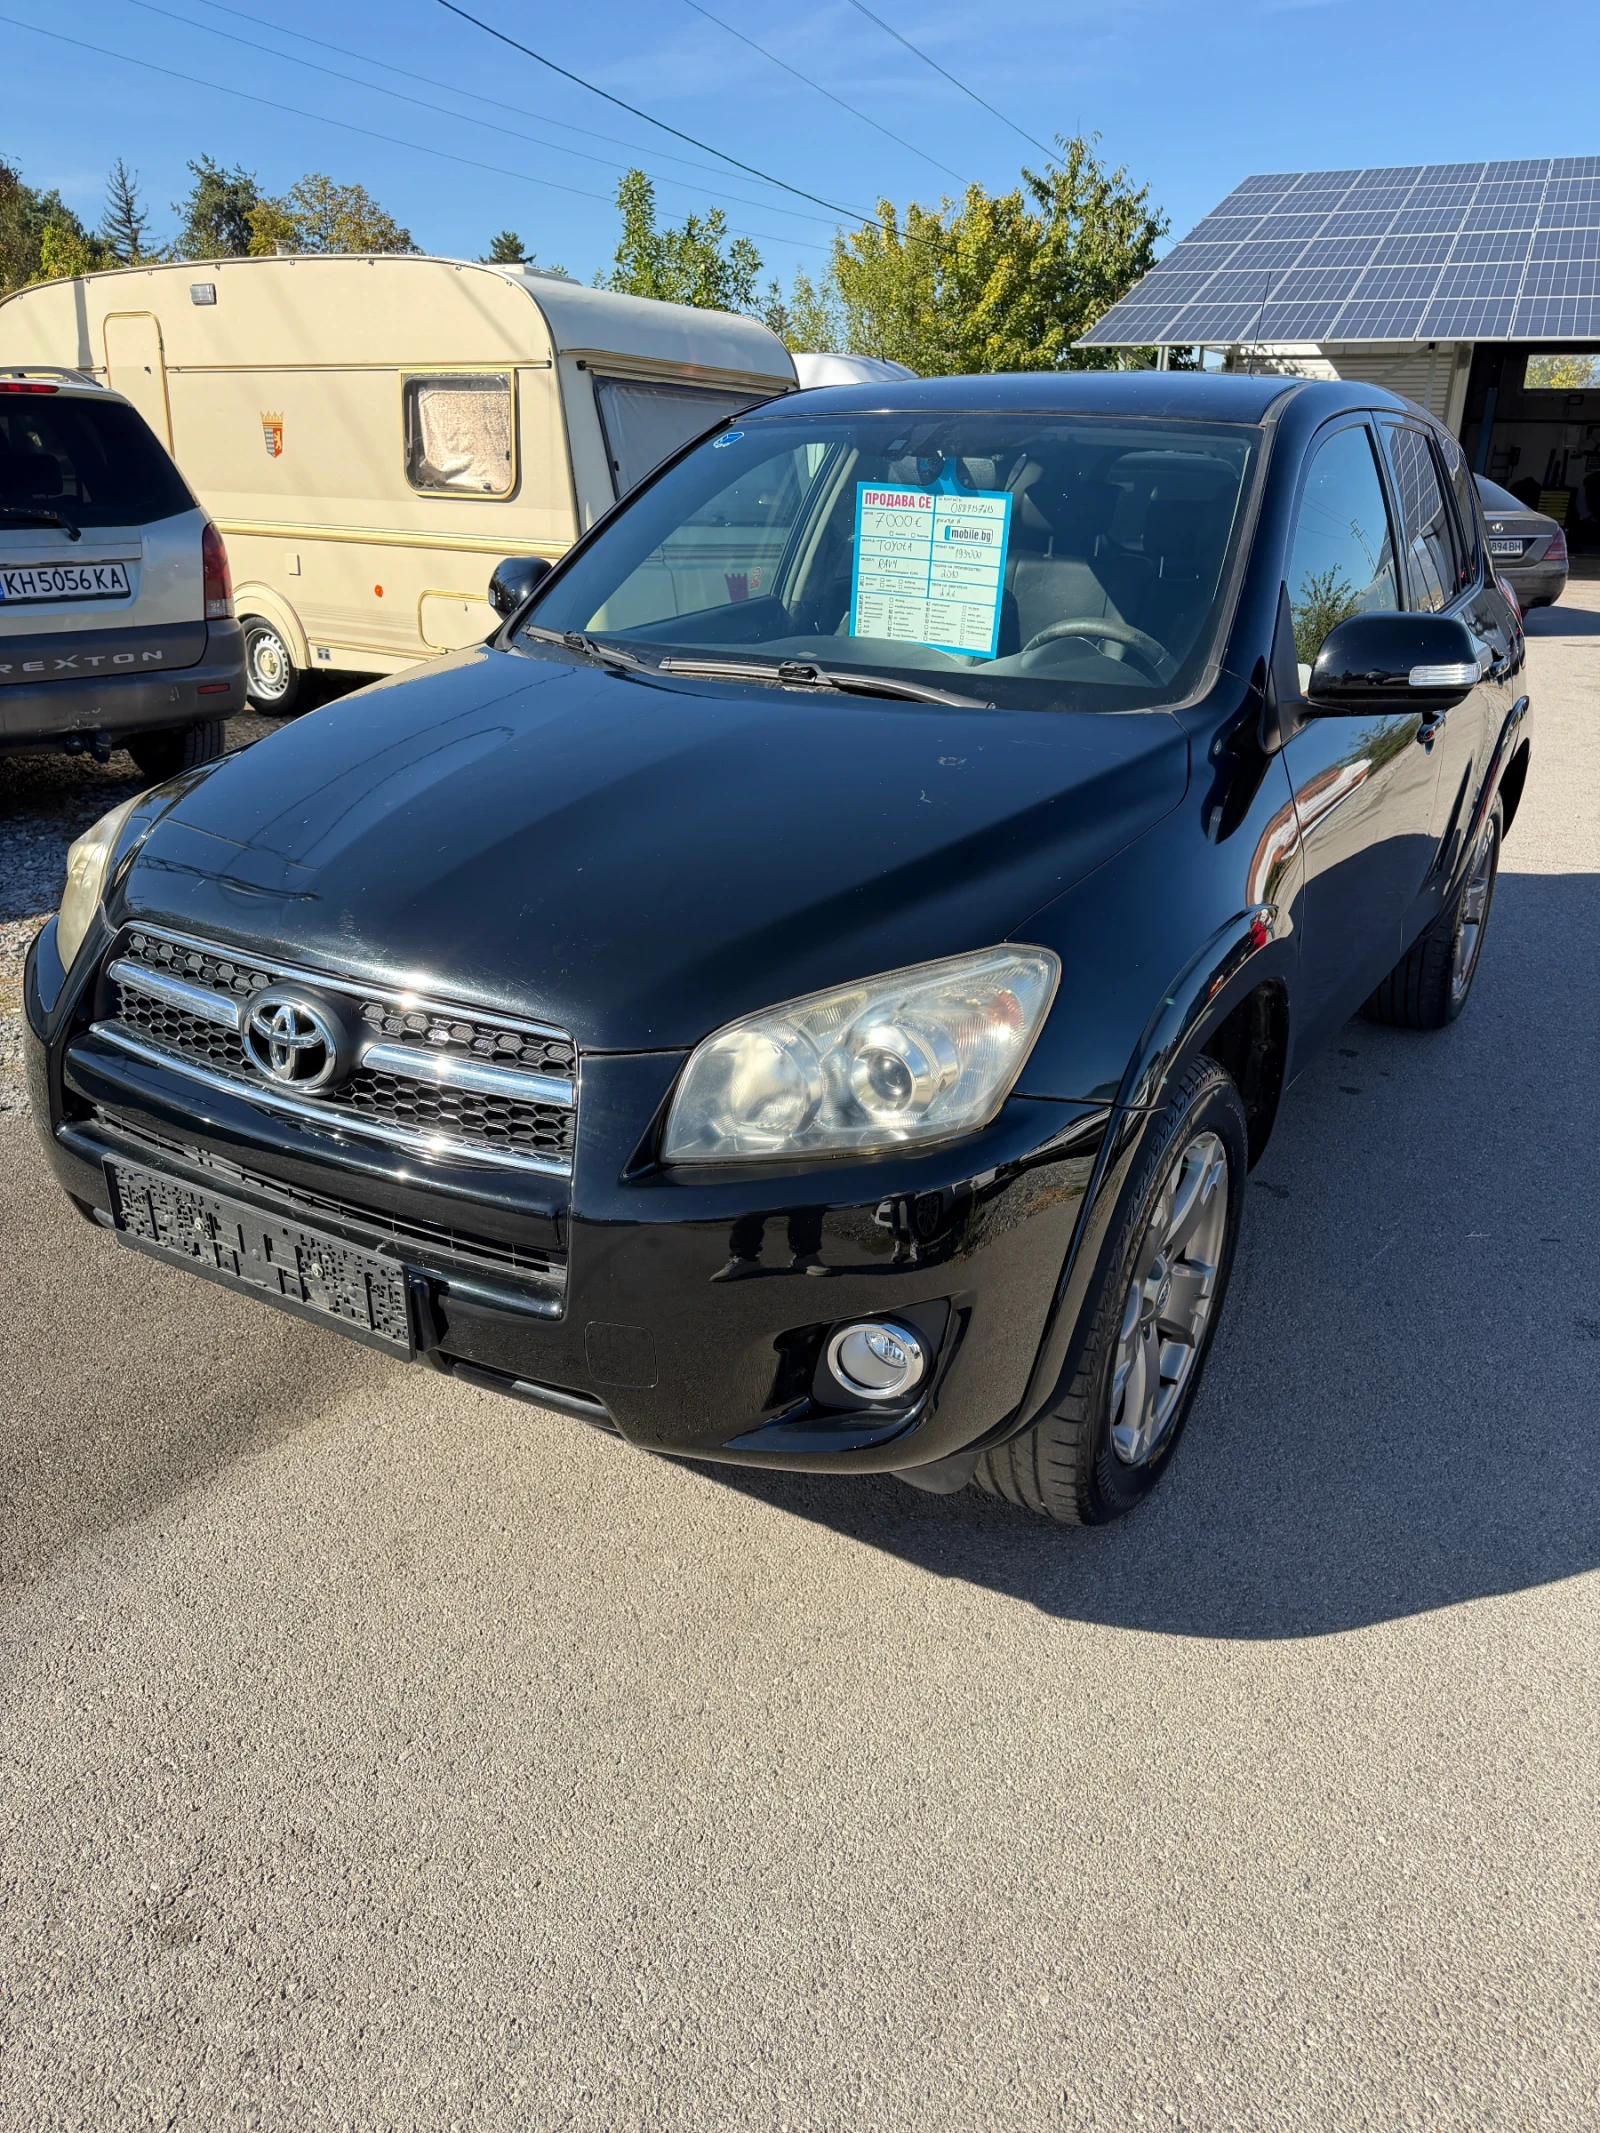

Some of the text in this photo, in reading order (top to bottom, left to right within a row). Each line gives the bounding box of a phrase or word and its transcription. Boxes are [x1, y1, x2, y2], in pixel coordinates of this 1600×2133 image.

[865, 492, 932, 509] ПРОДАВА СЕ
[952, 528, 992, 542] mobile.bg
[1490, 541, 1521, 552] 894BH
[3, 568, 124, 595] KH5056KA
